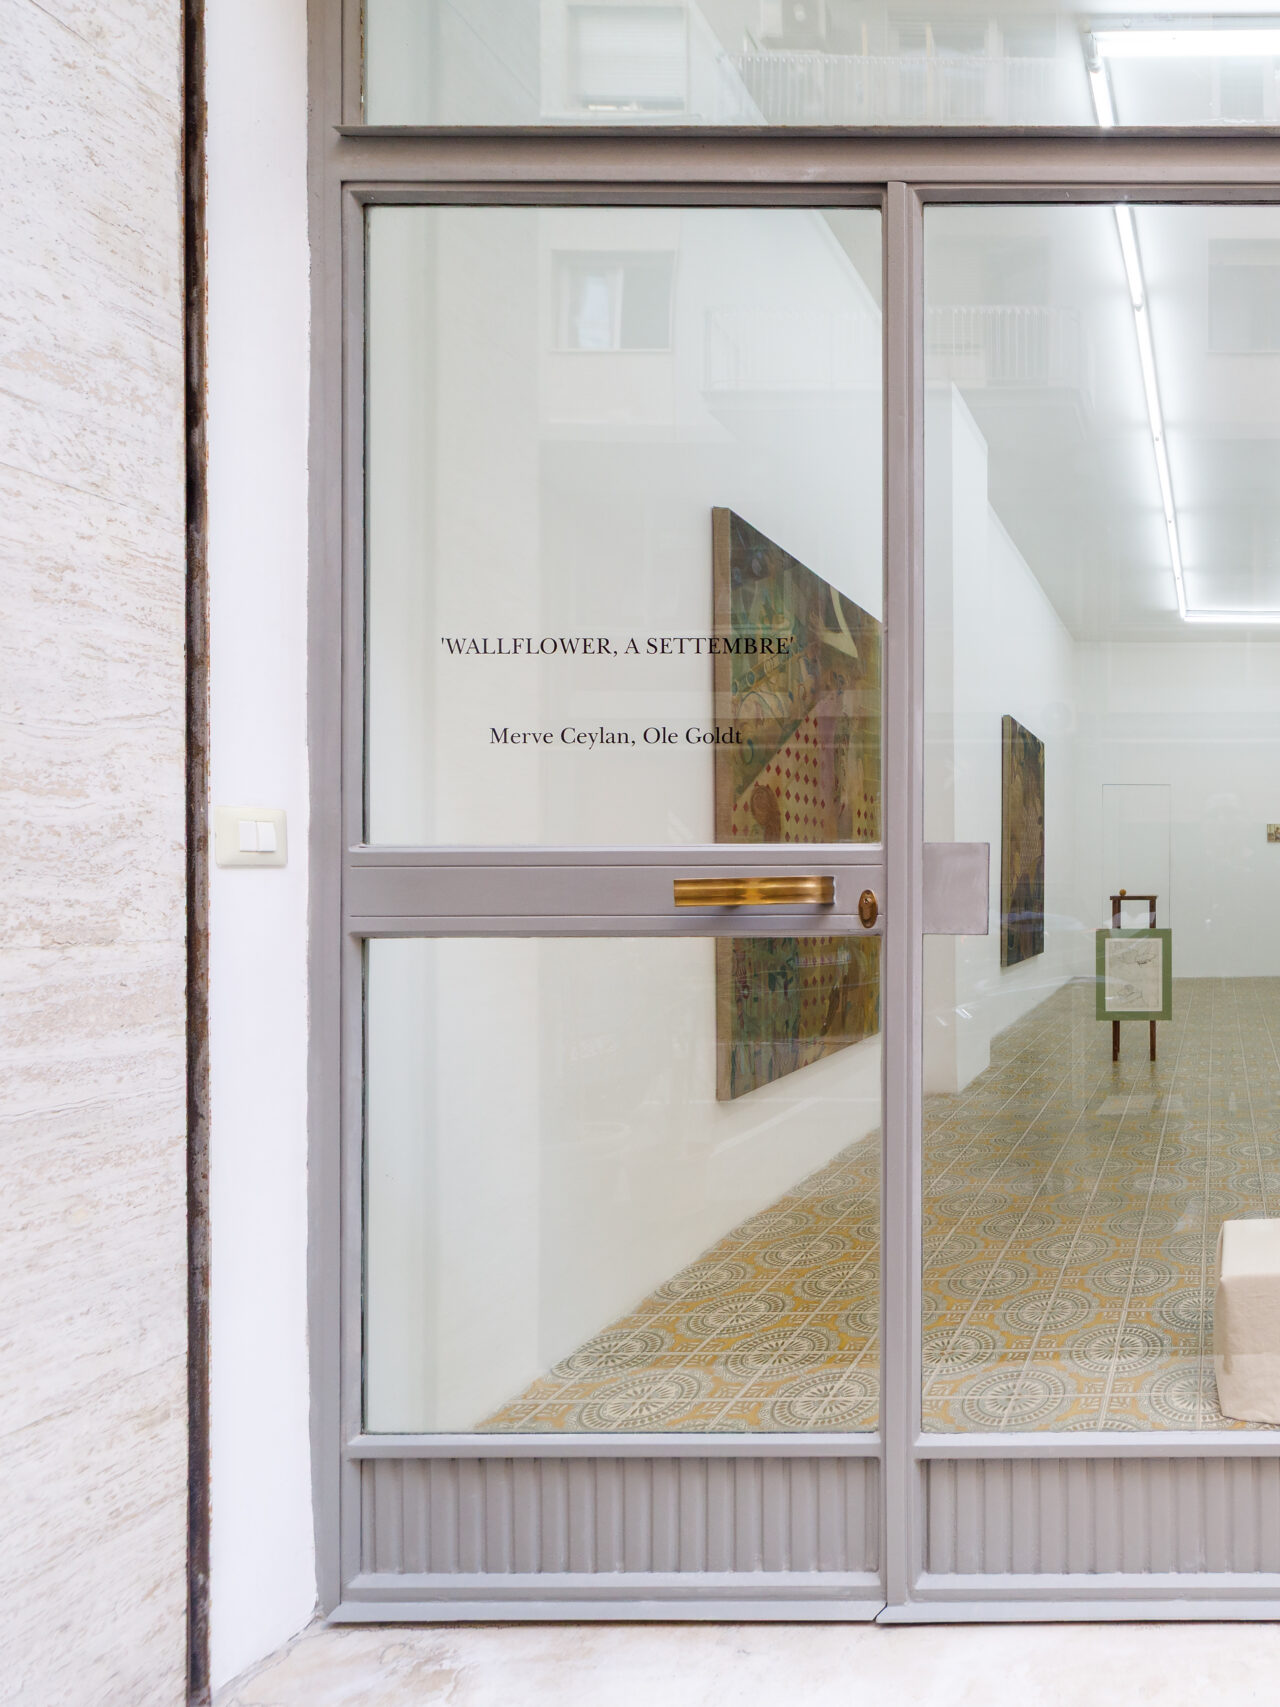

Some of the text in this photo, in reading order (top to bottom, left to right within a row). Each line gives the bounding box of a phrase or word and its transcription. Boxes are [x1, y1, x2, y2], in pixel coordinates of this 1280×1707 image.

[441, 636, 794, 657] 'WALLFLOWER, A SETTEMBRE'
[490, 726, 743, 750] Merve Ceylan, Ole Goldt
